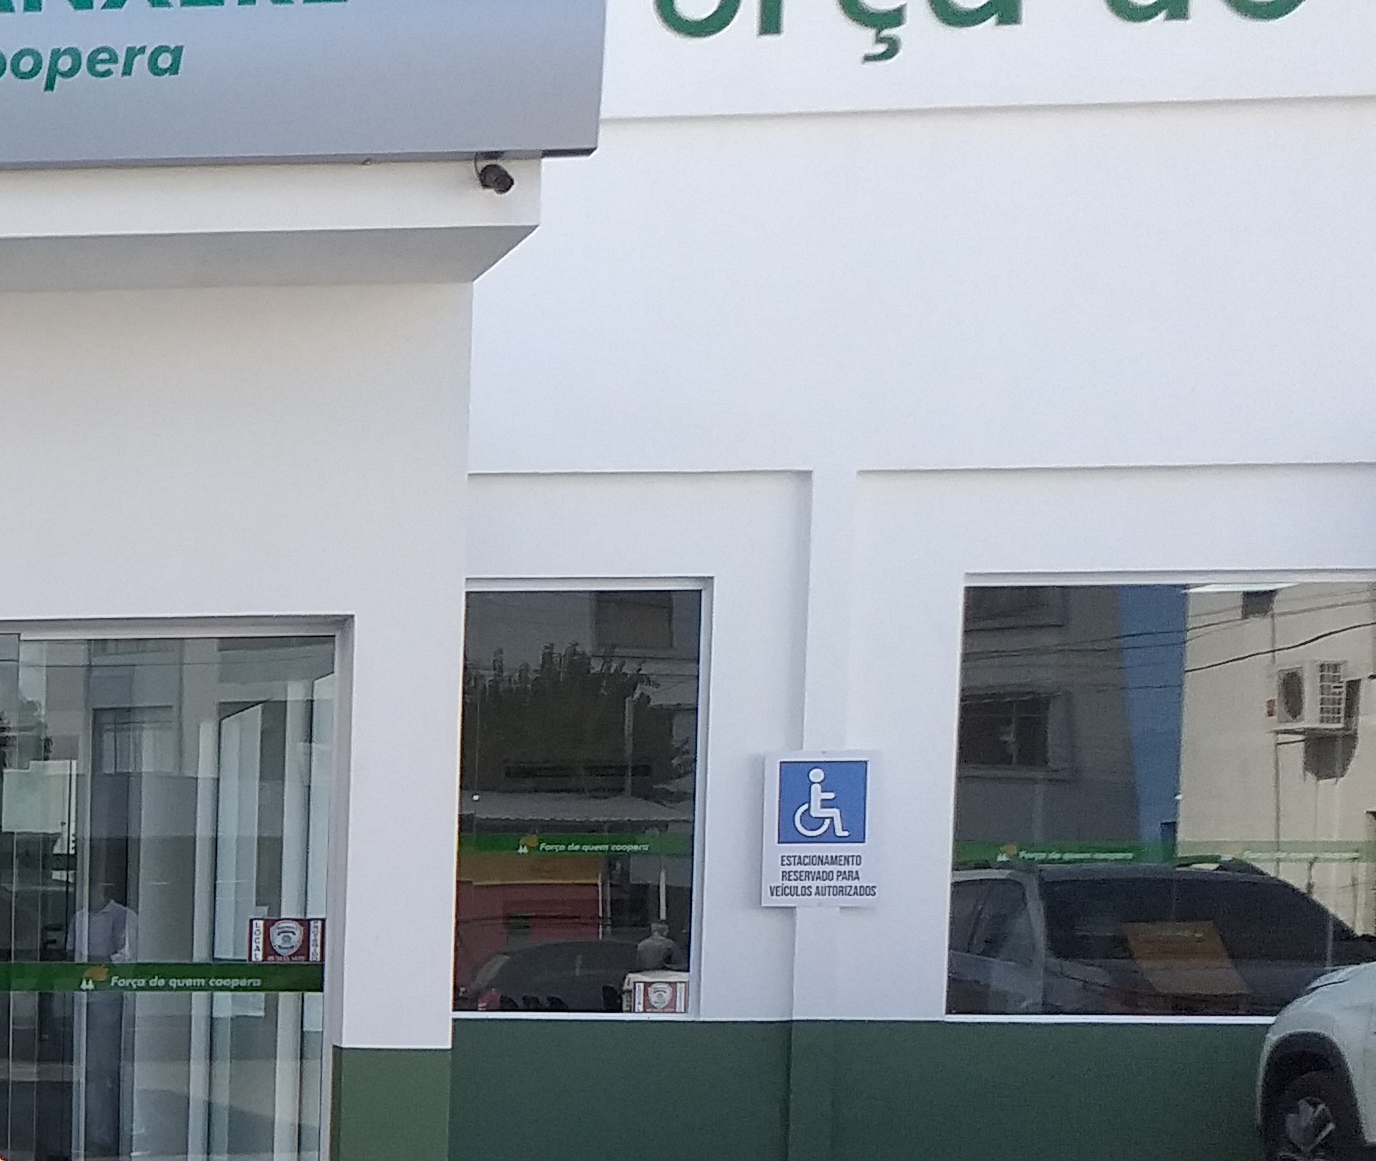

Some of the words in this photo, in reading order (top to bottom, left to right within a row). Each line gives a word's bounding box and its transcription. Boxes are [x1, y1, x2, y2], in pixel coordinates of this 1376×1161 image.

[780, 854, 862, 866] ESTACIONAMENTO
[781, 870, 834, 881] RESERVADO
[836, 870, 860, 881] PARA
[769, 883, 813, 897] VEÍCULOS
[814, 885, 877, 897] AUTORIZADOS
[253, 922, 262, 960] LOCAL
[110, 976, 146, 989] Força
[149, 976, 165, 987] de
[169, 977, 205, 989] quem
[209, 977, 262, 990] coopera
